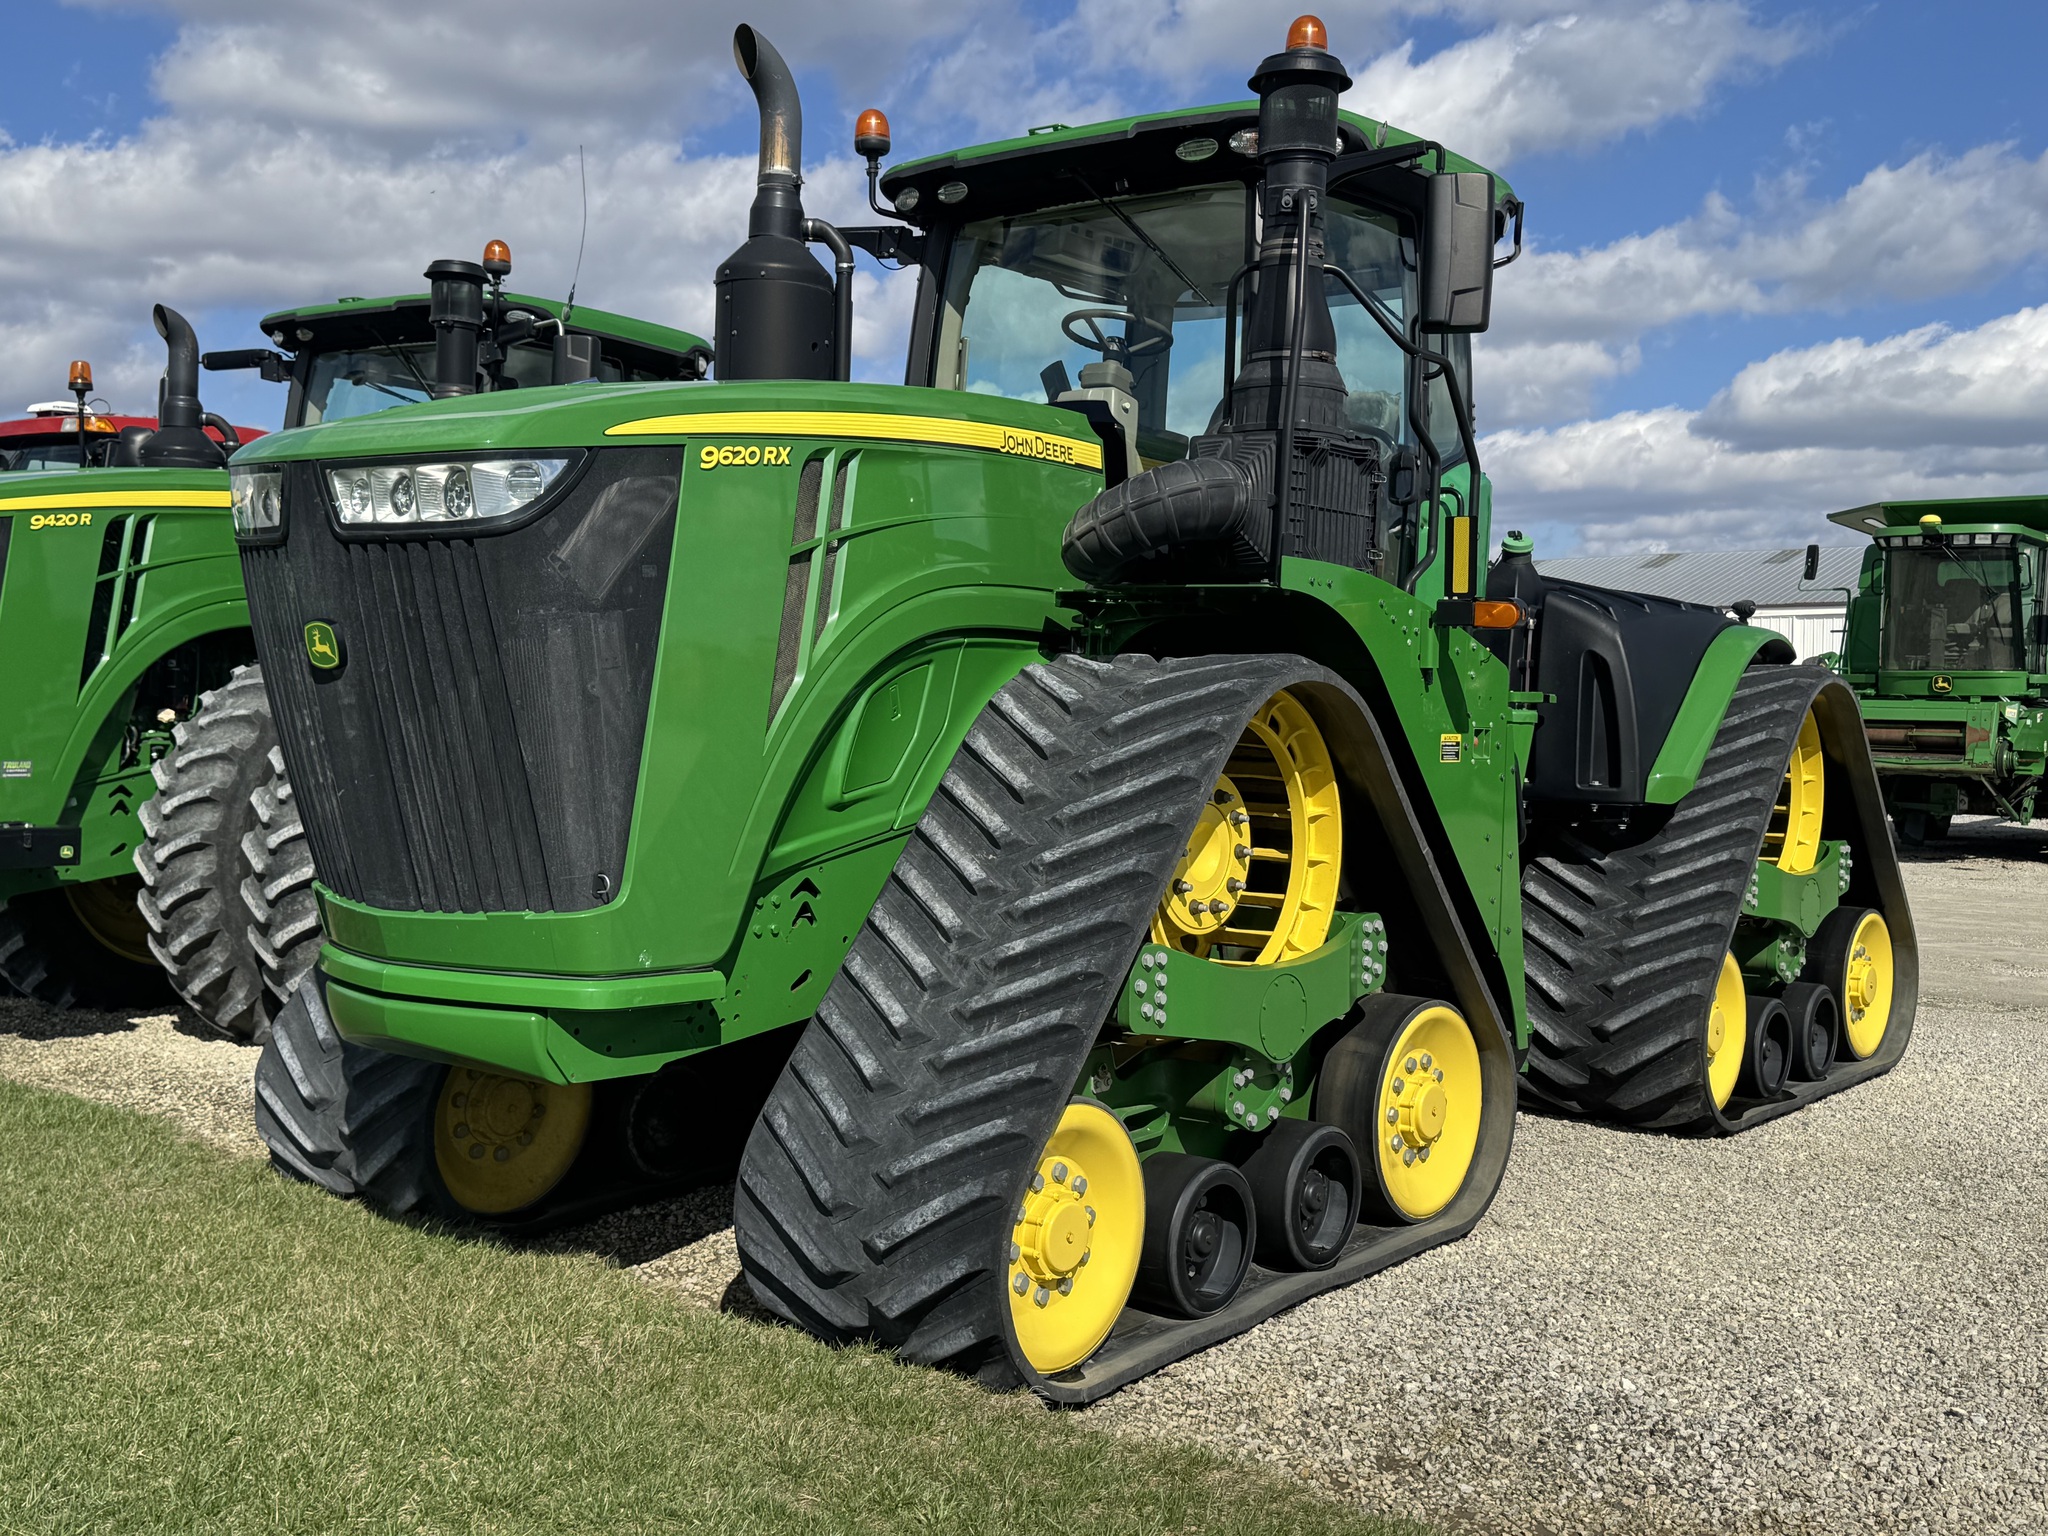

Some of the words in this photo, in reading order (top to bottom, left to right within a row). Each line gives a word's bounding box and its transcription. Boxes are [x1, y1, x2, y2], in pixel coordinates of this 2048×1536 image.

[700, 445, 761, 470] 9620
[763, 446, 793, 466] RX
[1000, 430, 1034, 454] JOHN
[1035, 436, 1074, 462] DEERE
[29, 513, 79, 530] 9420
[80, 512, 92, 526] R
